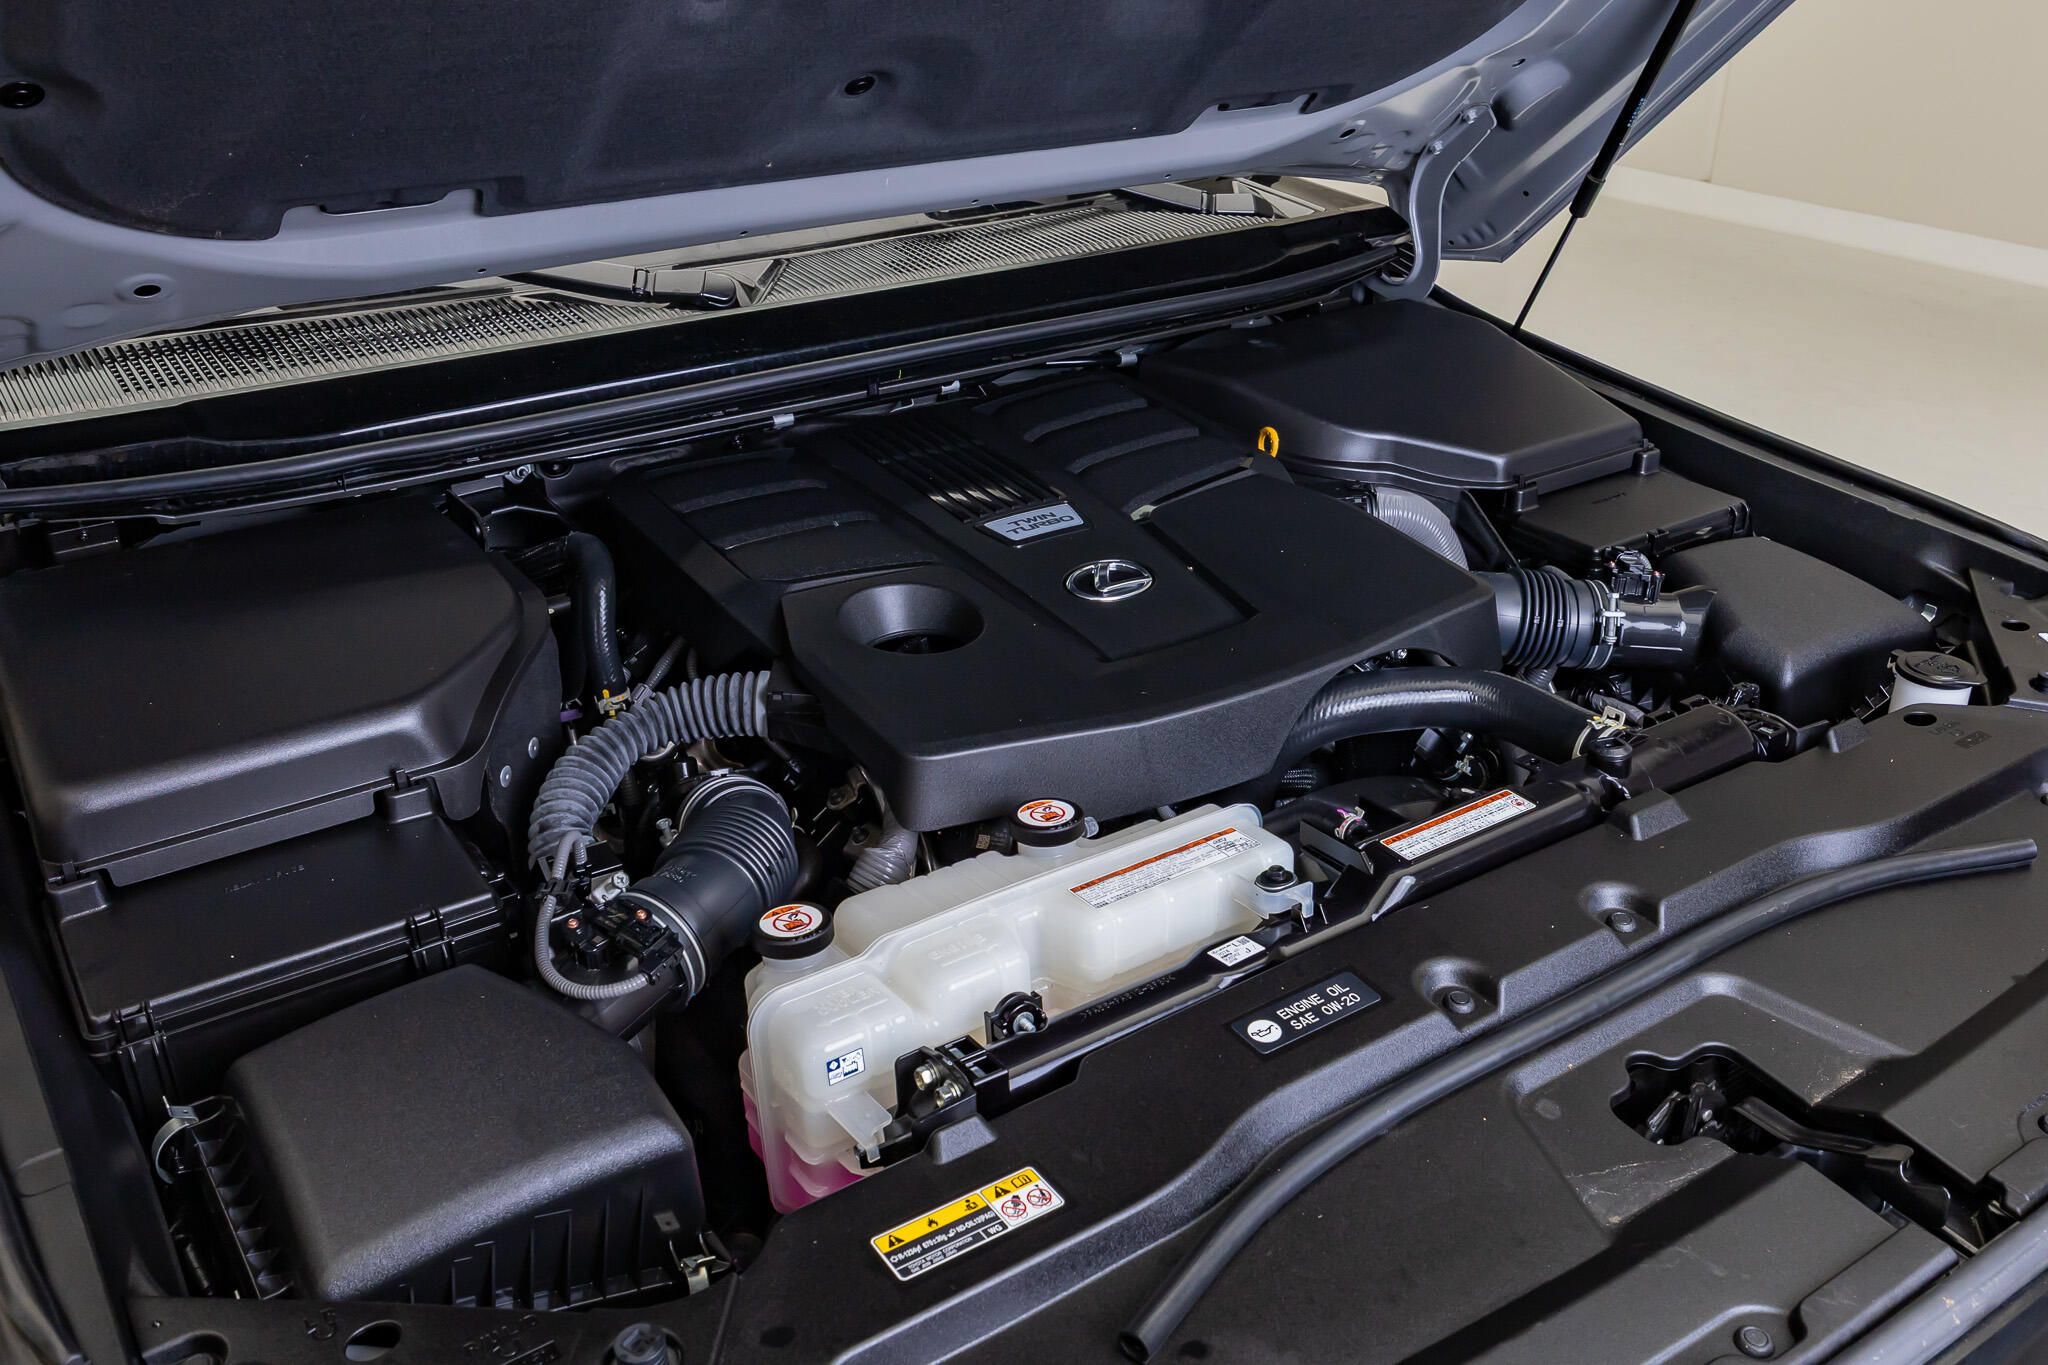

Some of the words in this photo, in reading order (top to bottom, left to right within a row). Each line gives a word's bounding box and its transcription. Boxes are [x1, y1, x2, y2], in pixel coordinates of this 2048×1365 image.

[1006, 515, 1074, 534] TURBO
[1008, 511, 1057, 527] TWIN
[1276, 993, 1325, 1020] ENGINE
[1326, 983, 1351, 997] OIL
[1290, 1011, 1320, 1030] SAE
[1321, 992, 1361, 1015] 0W-20
[987, 1224, 1004, 1235] WG
